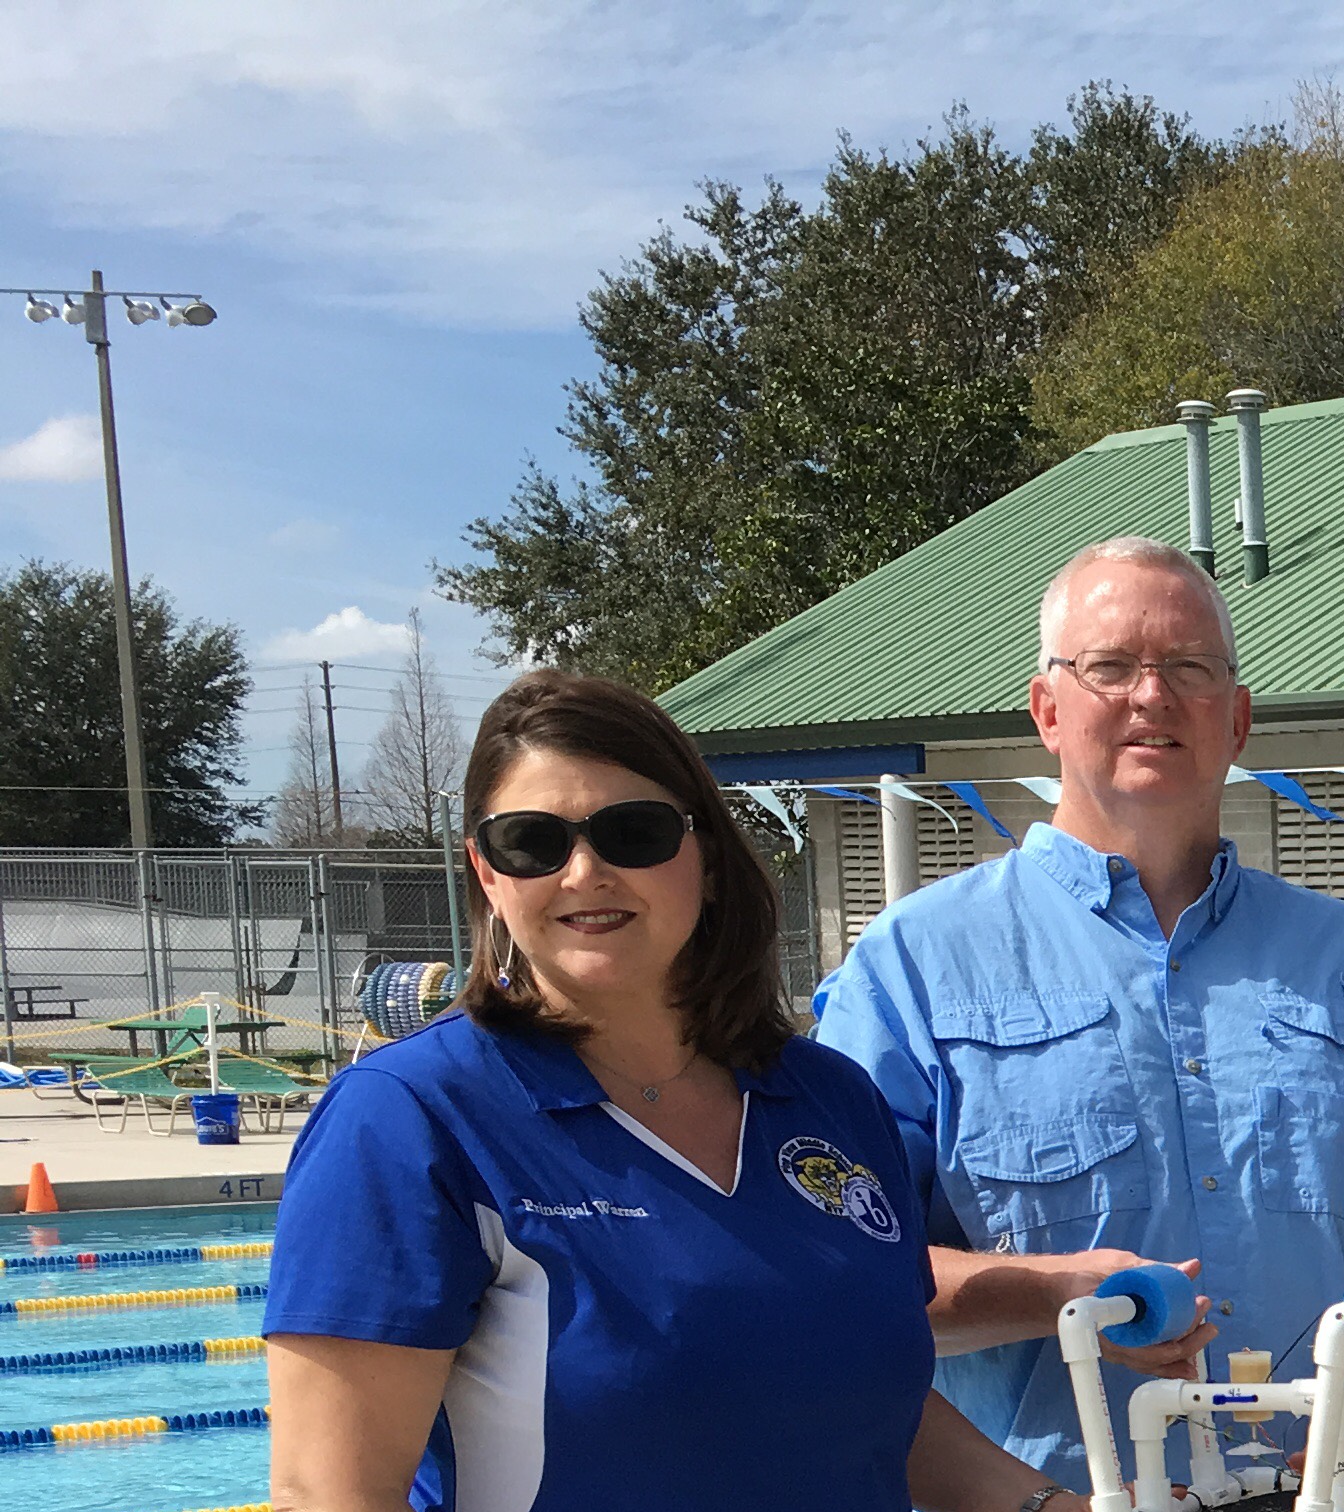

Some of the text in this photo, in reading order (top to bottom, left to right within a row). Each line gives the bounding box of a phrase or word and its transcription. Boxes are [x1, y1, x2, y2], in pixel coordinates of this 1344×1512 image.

[219, 1177, 265, 1198] 4 FT
[521, 1198, 650, 1220] Principal Warren
